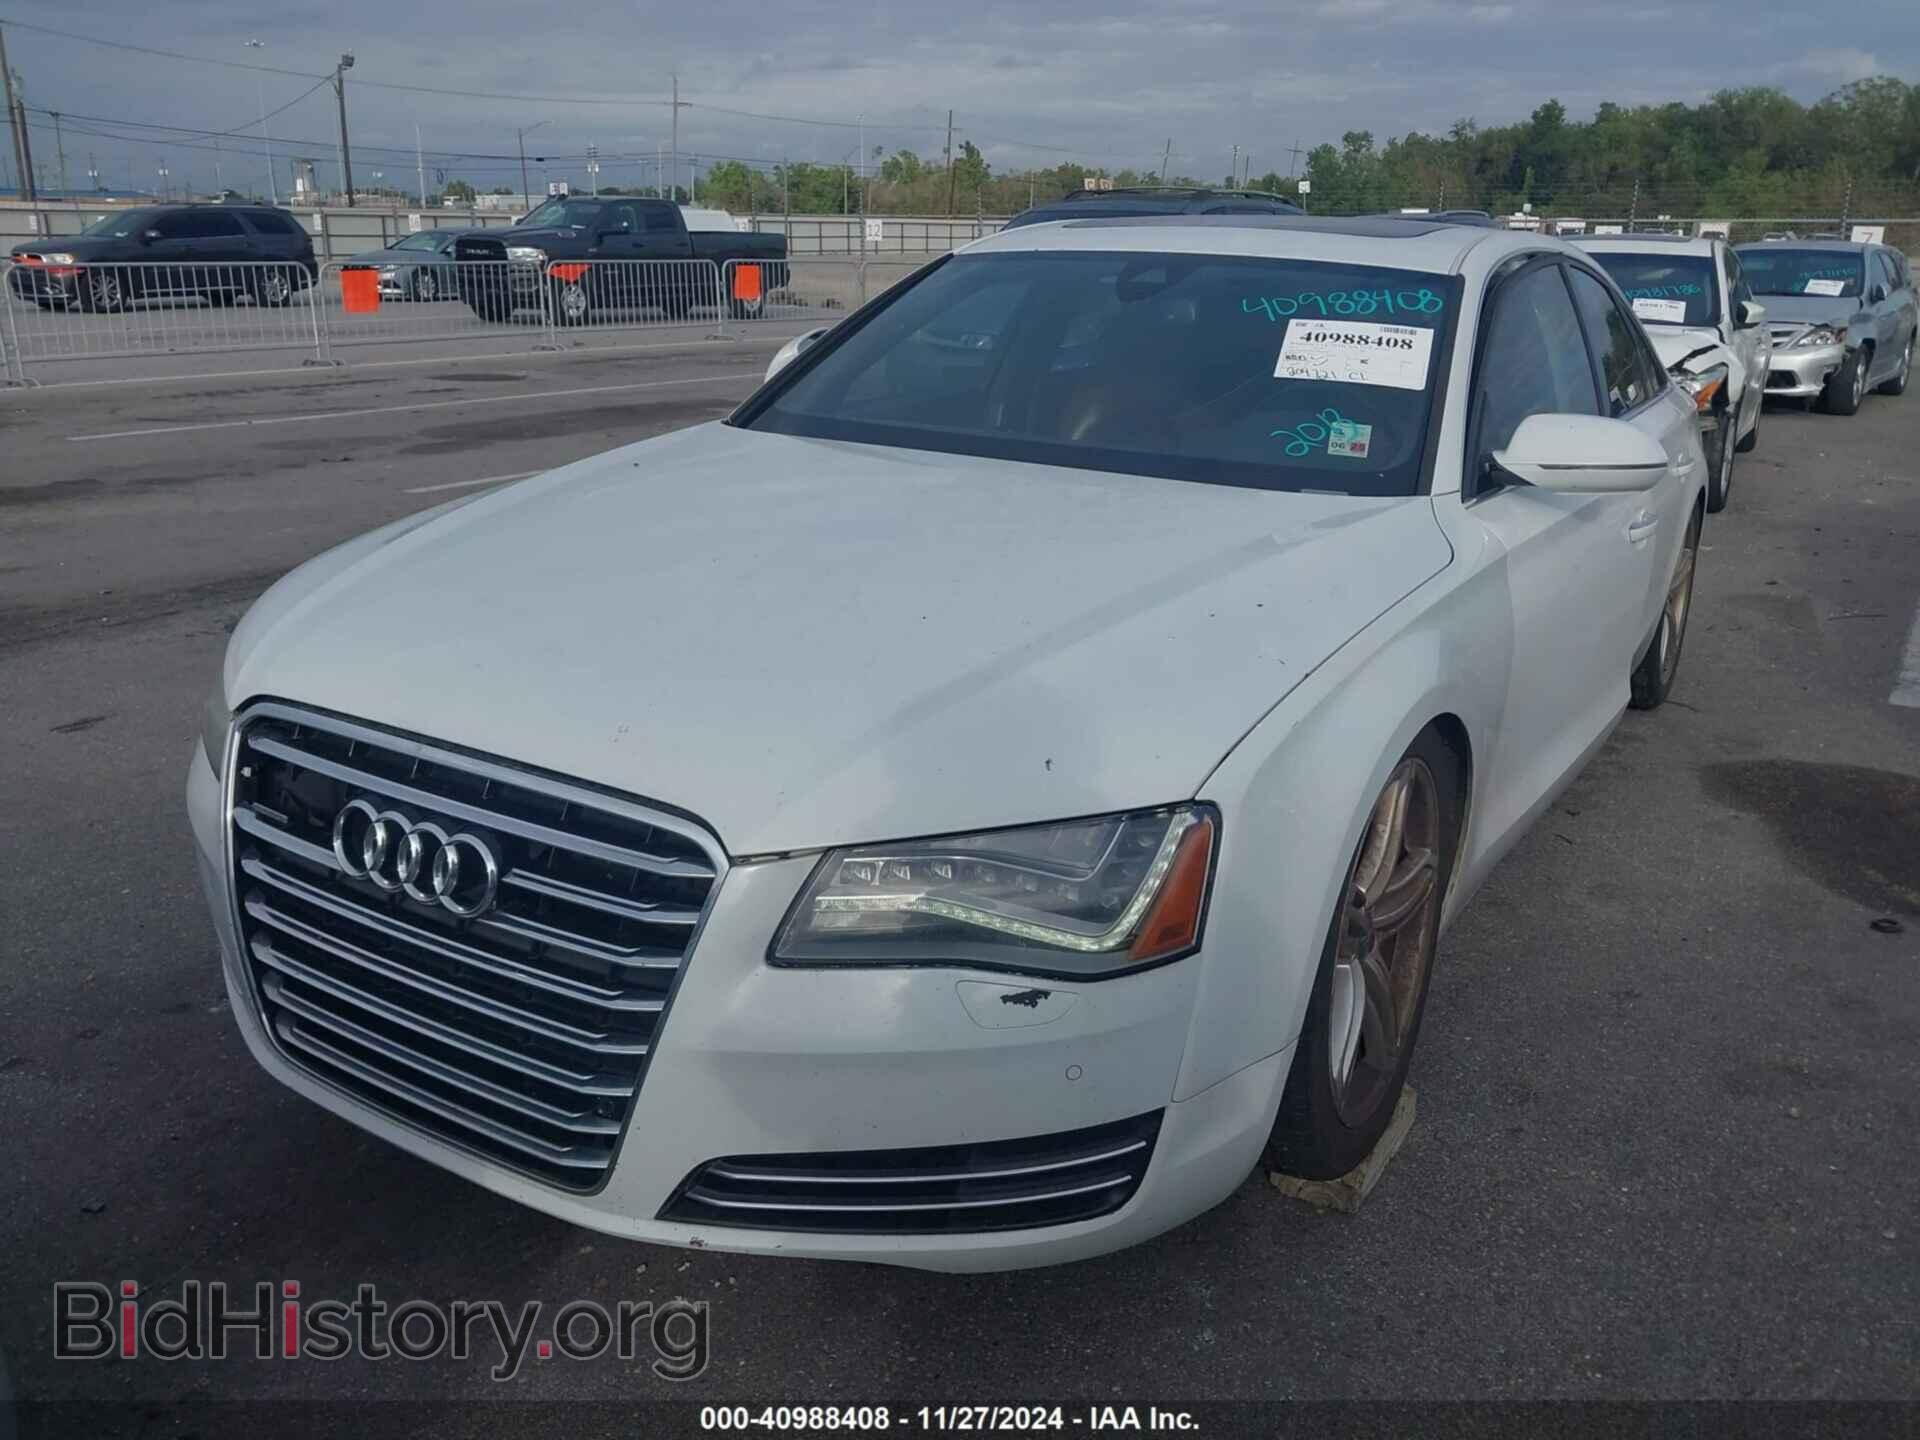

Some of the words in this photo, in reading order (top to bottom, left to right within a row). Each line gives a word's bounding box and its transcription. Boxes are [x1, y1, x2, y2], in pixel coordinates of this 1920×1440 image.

[868, 223, 880, 237] 12
[1242, 289, 1444, 322] 40988408
[1299, 331, 1414, 350] 40988408
